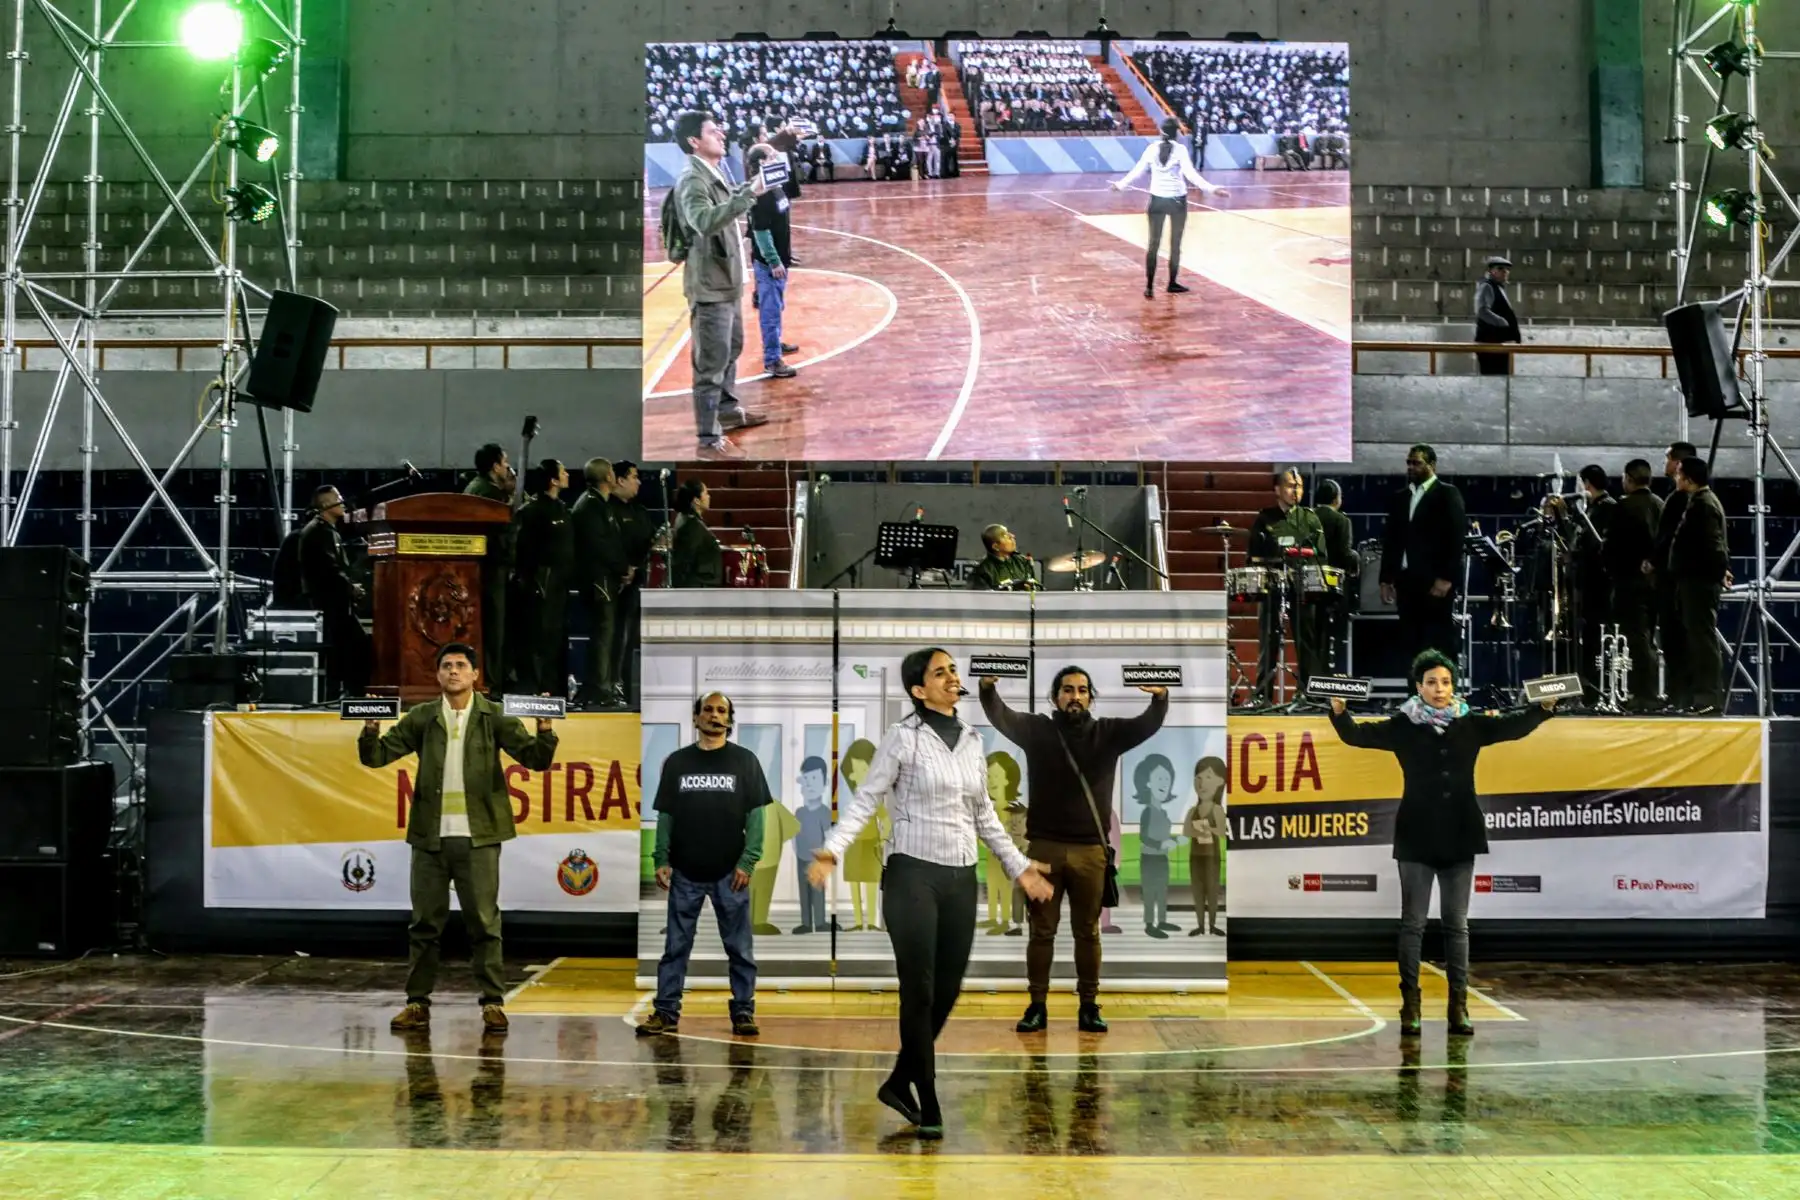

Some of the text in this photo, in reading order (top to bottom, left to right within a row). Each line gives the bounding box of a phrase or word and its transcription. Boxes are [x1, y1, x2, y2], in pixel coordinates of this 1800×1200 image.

[971, 661, 1028, 672] INDIFERENCIA
[1124, 669, 1180, 680] INDIGNACIÓN
[1310, 681, 1367, 692] FRUSTRACIÓN
[1539, 682, 1566, 693] MIEDO
[348, 705, 392, 714] DENUNCIA
[508, 701, 561, 712] IMPOTENCIA
[680, 775, 733, 790] ACOSADOR
[1482, 800, 1702, 829] enciaTambiénEsViolencia
[1240, 816, 1276, 840] LAS
[1281, 812, 1369, 839] MUJERES
